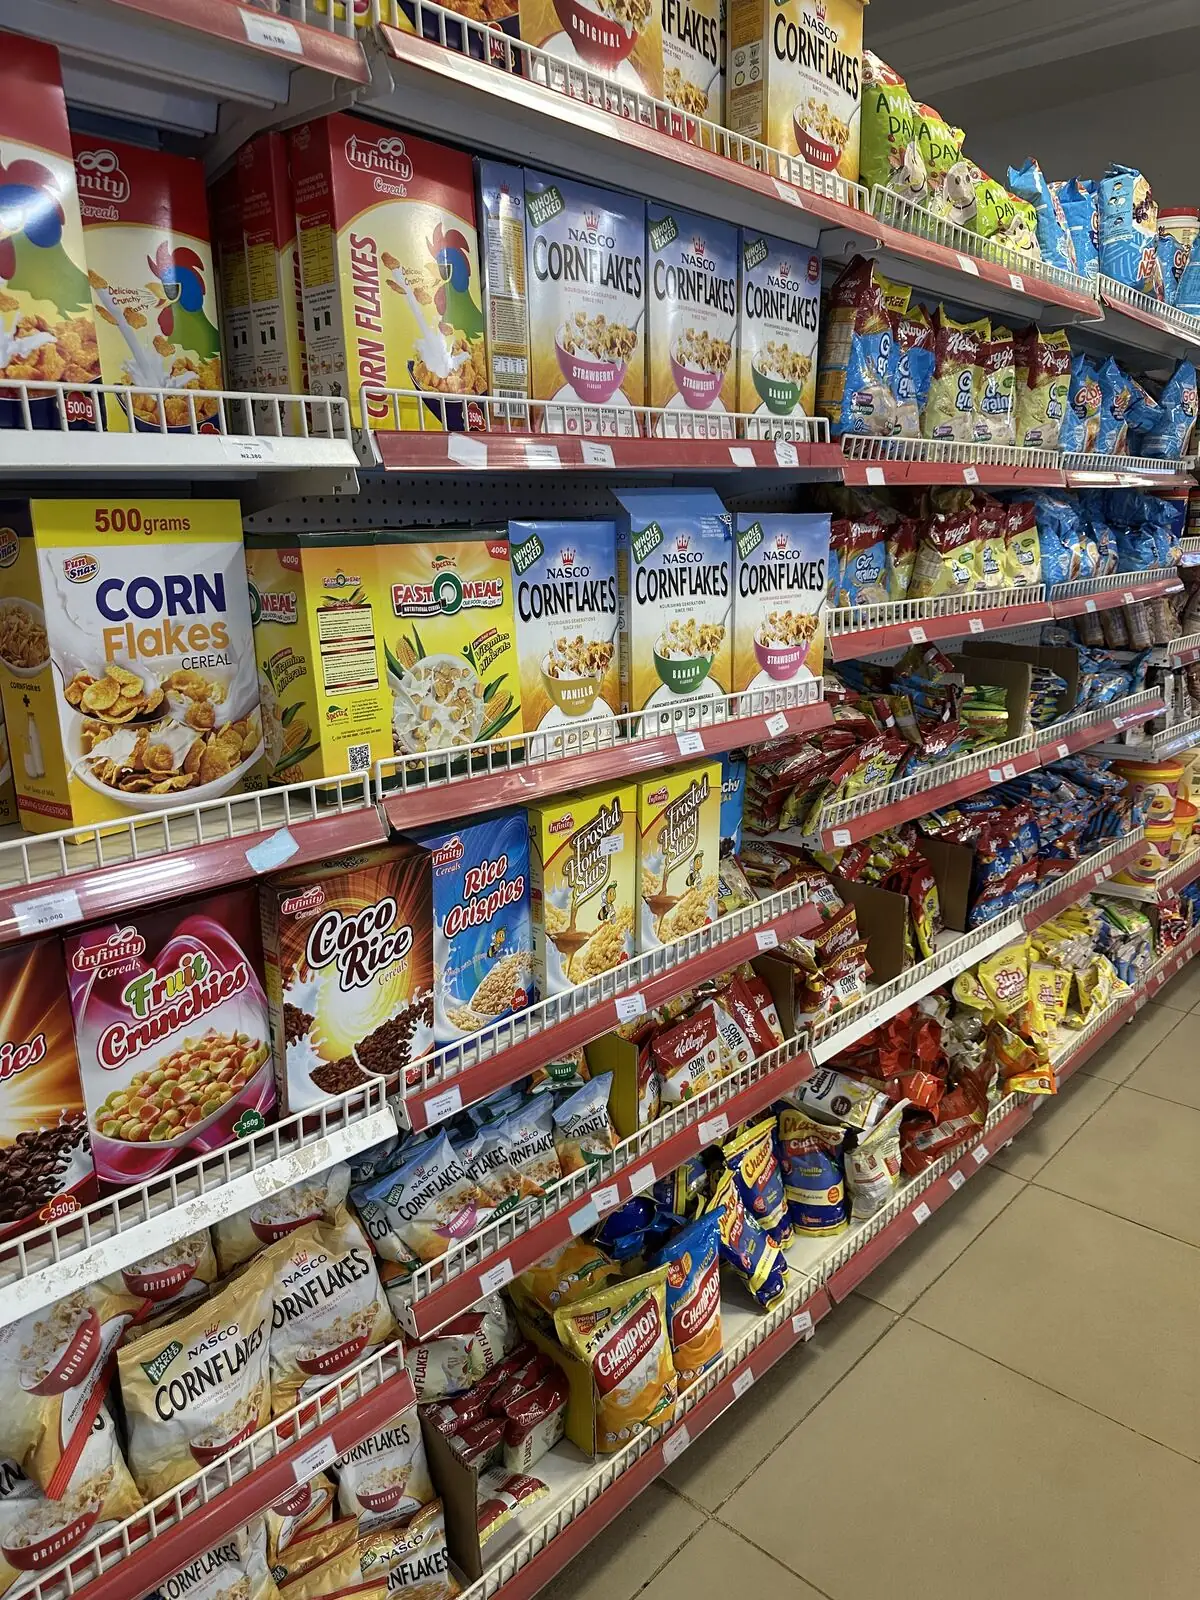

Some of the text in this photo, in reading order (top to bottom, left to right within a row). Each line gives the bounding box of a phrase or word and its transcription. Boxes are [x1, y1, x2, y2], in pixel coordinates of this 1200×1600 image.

[572, 14, 620, 48] ORIGINAL
[802, 12, 839, 43] NASCO
[773, 13, 860, 101] CORNFLAKES
[349, 140, 410, 178] Infinity
[804, 142, 833, 163] ORIGINAL
[930, 143, 961, 162] DAY
[373, 177, 408, 198] Cereals
[529, 187, 558, 213] WHOLE
[533, 199, 562, 226] FLAKED
[568, 227, 615, 249] NASCO
[651, 217, 674, 238] WHOLE
[654, 226, 677, 251] FLAKED
[680, 253, 716, 272] NASCO
[745, 240, 766, 260] WHOLE
[746, 250, 767, 271] FLAKED
[532, 234, 642, 301] CORNFLAKES
[108, 285, 139, 296] Delicious
[349, 232, 387, 333] FLAKES
[653, 259, 735, 318] CORNFLAKES
[767, 275, 800, 292] NASCO
[112, 295, 141, 306] Crunchy
[745, 281, 818, 333] CORNFLAKES
[359, 337, 389, 418] CORN
[572, 365, 615, 382] STRAWBERRY
[682, 376, 716, 391] STRAWBERRY
[768, 387, 792, 399] BANANA
[67, 400, 93, 418] 500g
[633, 523, 658, 550] WHOLE
[636, 533, 662, 561] FLAKED
[737, 523, 760, 549] WHOLE
[740, 532, 762, 557] FLAKED
[282, 555, 299, 565] 400g
[491, 546, 507, 555] 400g
[513, 537, 538, 564] WHOLE
[516, 546, 542, 573] FLAKED
[662, 552, 704, 565] NASCO
[763, 550, 801, 562] NASCO
[64, 558, 87, 573] Fun
[68, 563, 97, 581] Snax
[431, 558, 457, 572] Spectra
[546, 566, 591, 579] NASCO
[739, 559, 825, 598] CORNFLAKES
[635, 561, 728, 605] CORNFLAKES
[95, 572, 227, 623] CORN
[517, 575, 616, 623] CORNFLAKES
[102, 618, 231, 663] Flakes
[181, 654, 233, 671] CEREAL
[766, 651, 800, 665] STRAWBERRY
[672, 665, 701, 680] BANANA
[560, 685, 594, 701] VANILLA
[244, 782, 263, 792] 500g
[18, 797, 70, 816] SERVING SUGGESTION
[667, 778, 708, 826] Frosted
[549, 818, 574, 834] Infinity
[573, 801, 620, 853] Frosted
[660, 810, 698, 846] Honey
[668, 832, 694, 857] Stars
[435, 862, 462, 877] Cereals
[566, 845, 604, 878] Hone
[464, 855, 508, 898] Rice
[578, 861, 607, 890] Stars
[283, 891, 325, 912] Infinity
[444, 876, 525, 938] Crispies
[308, 898, 396, 966] Coco
[78, 938, 144, 969] Infinity
[342, 927, 412, 988] Rice
[98, 959, 142, 980] Cereals
[377, 959, 408, 986] Cereals
[839, 972, 856, 987] CORN
[125, 952, 209, 1017] Fruit
[840, 981, 859, 994] FLAKES
[100, 963, 246, 1067] Crunchies
[734, 999, 762, 1043] Kellogg's
[673, 1029, 708, 1059] Kellogg's
[720, 1027, 736, 1051] FLAKES
[727, 1023, 745, 1046] CORN
[687, 1054, 706, 1072] CORN
[689, 1064, 706, 1080] FLAKES
[242, 1115, 259, 1129] 350g
[513, 1129, 540, 1147] NASCO
[397, 1160, 465, 1222] CORNFLAKES
[410, 1165, 439, 1191] NASCO
[50, 1200, 76, 1221] 350g
[449, 1207, 474, 1235] STRAWBERRY
[143, 1270, 188, 1293] ORIGINAL
[282, 1254, 328, 1288] NASCO
[271, 1247, 370, 1329] ORNFLAKES
[680, 1268, 720, 1329] CHAMPION
[187, 1323, 239, 1361] NASCO
[585, 1322, 611, 1353] 3-IN-1
[597, 1304, 658, 1376] CHAMPION
[60, 1326, 96, 1382] ORIGINAL
[147, 1341, 177, 1375] WHOLE
[153, 1348, 181, 1384] FLAKED
[318, 1342, 361, 1370] ORIGINAL
[417, 1348, 429, 1382] FLAKES
[612, 1331, 657, 1381] CUSTARD POWDER
[155, 1319, 266, 1423] CORNFLAKES
[370, 1489, 399, 1507] ORIGINAL
[33, 1519, 88, 1562] ORIGINAL
[379, 1532, 424, 1564] NASCO
